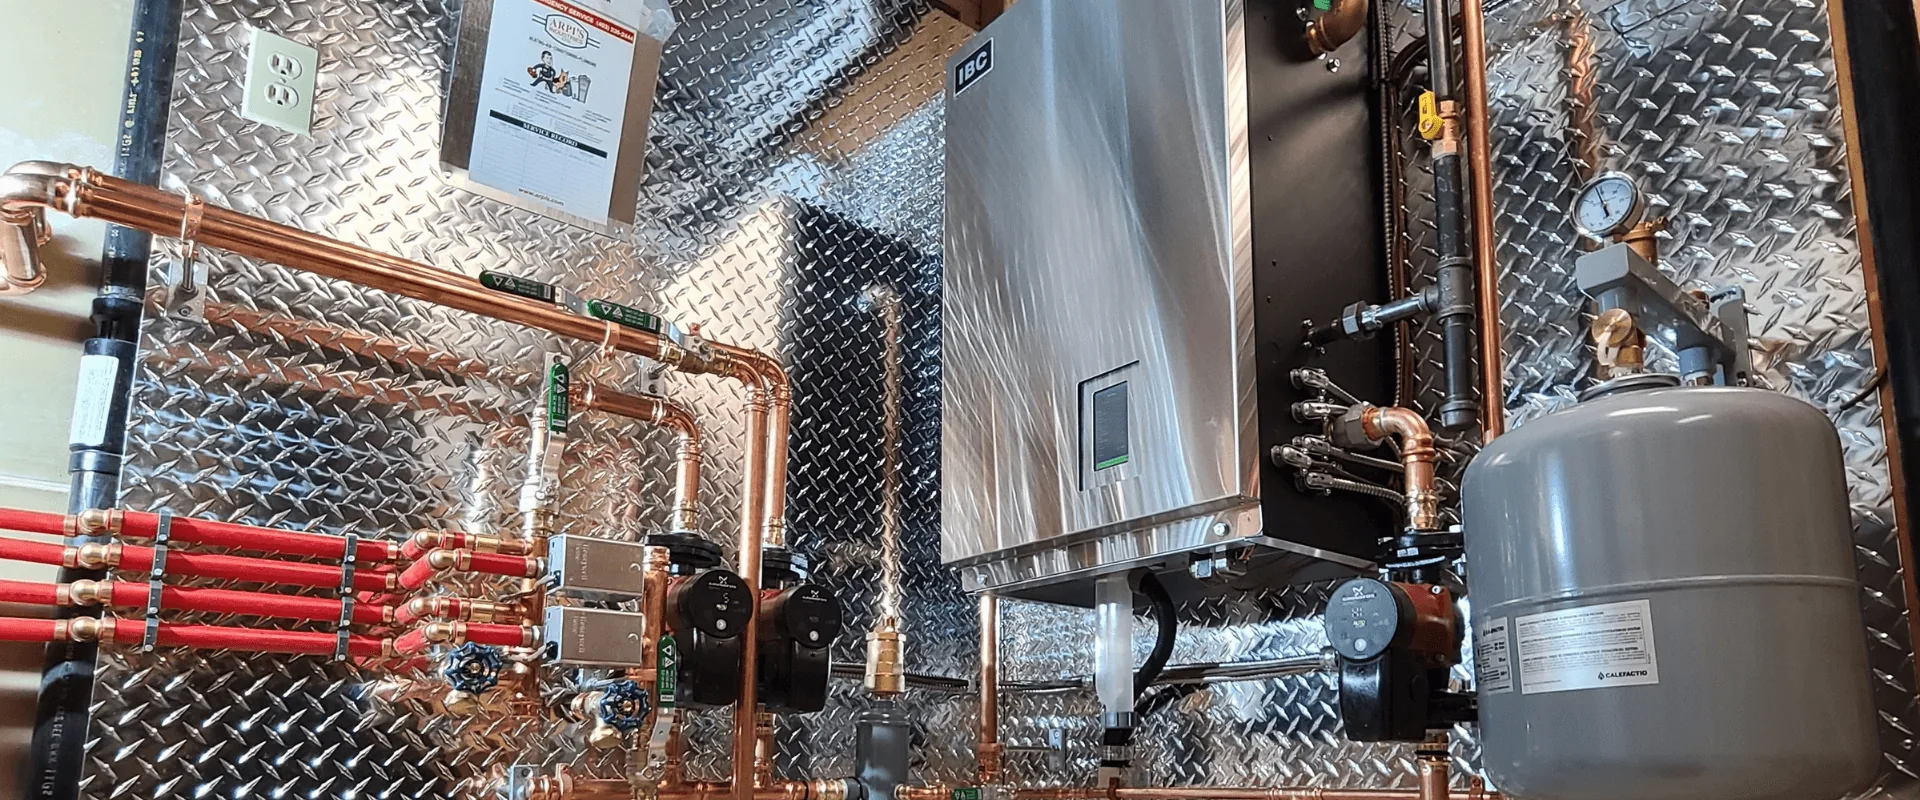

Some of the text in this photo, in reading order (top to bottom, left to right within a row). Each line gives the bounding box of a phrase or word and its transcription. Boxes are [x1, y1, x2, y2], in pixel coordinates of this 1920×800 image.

[549, 18, 585, 39] ARPI'S
[568, 8, 594, 23] SERVICE
[596, 20, 610, 31] (403)
[959, 51, 987, 85] IBC
[522, 122, 550, 138] SERVICE
[550, 132, 579, 147] RECORD
[1605, 670, 1648, 679] CALEFACTIO
